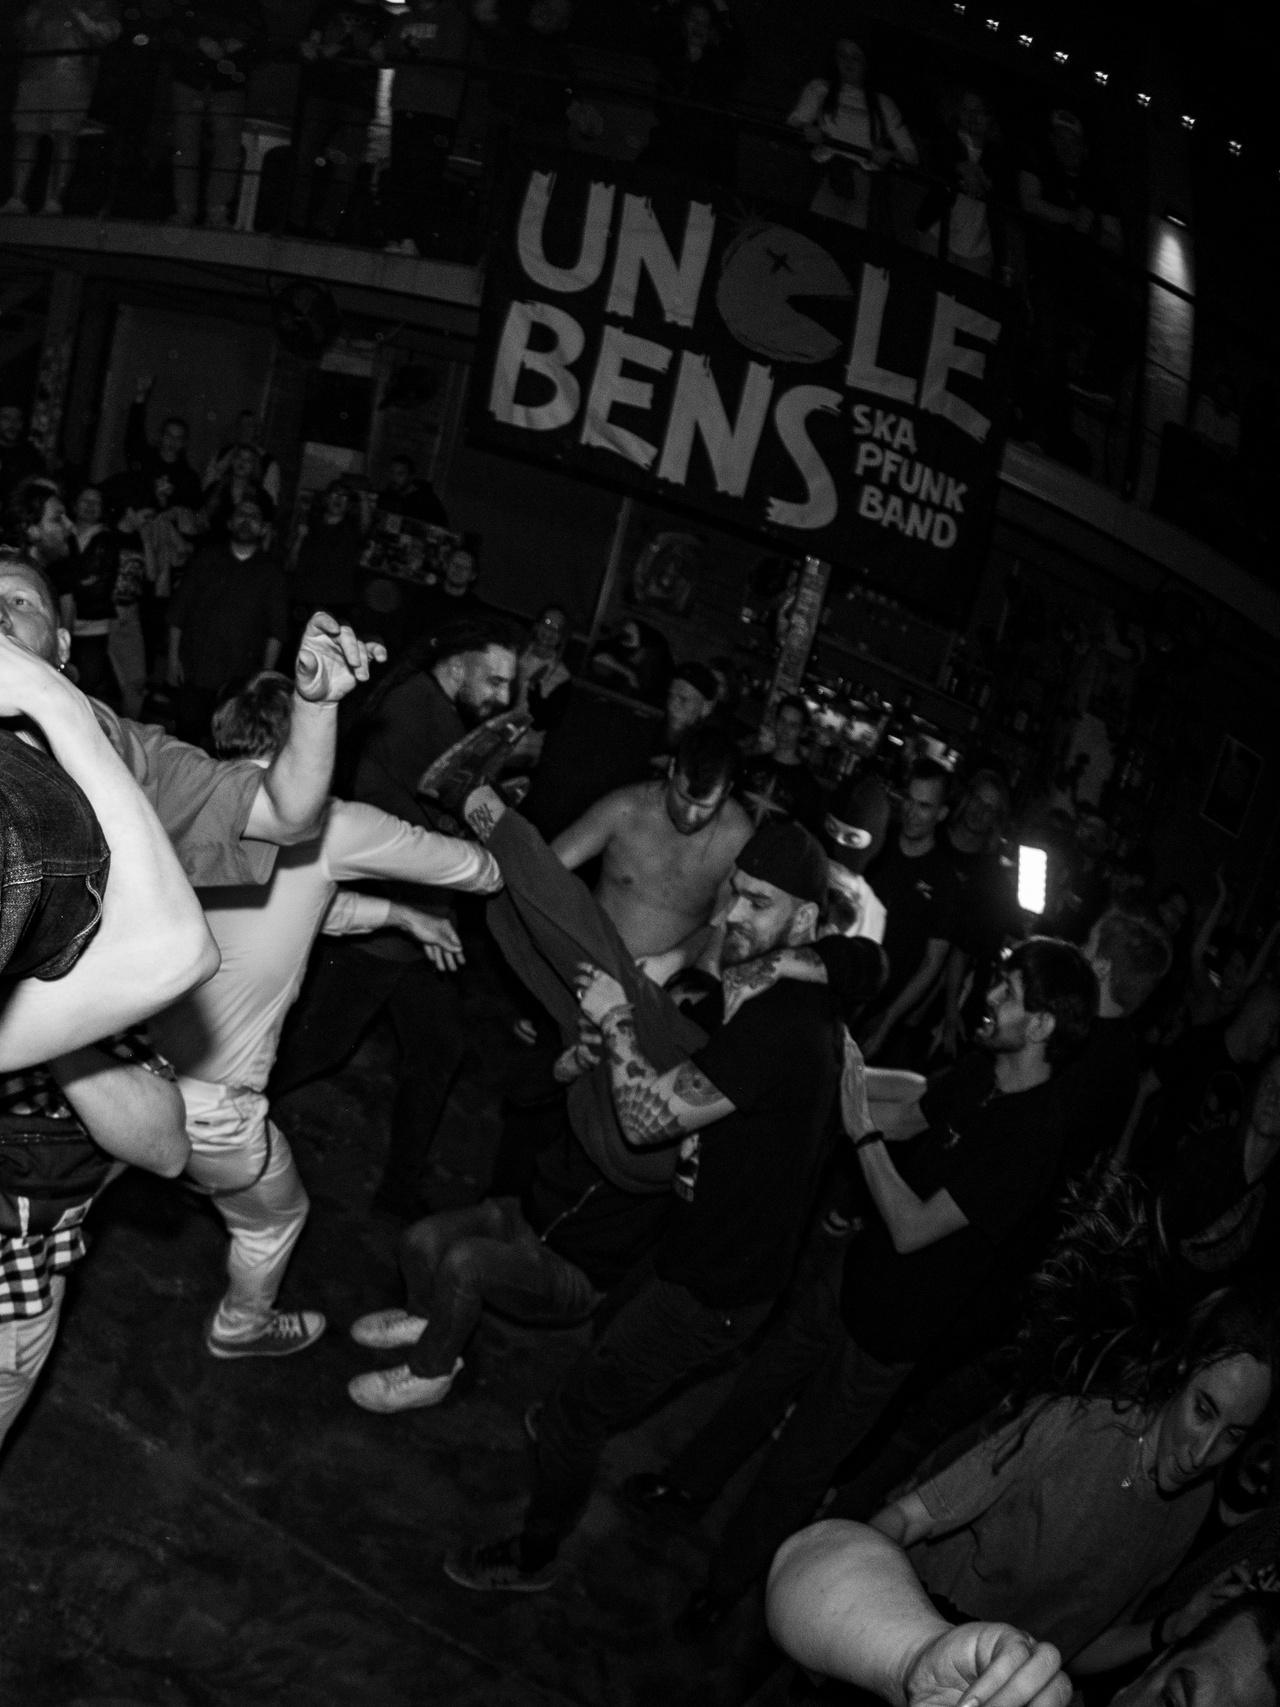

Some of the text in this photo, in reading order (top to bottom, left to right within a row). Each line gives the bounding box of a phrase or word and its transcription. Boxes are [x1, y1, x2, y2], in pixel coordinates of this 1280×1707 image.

[488, 300, 844, 530] BENS
[851, 403, 917, 455] SKA
[854, 441, 968, 513] PFUNK
[858, 491, 958, 549] BAND
